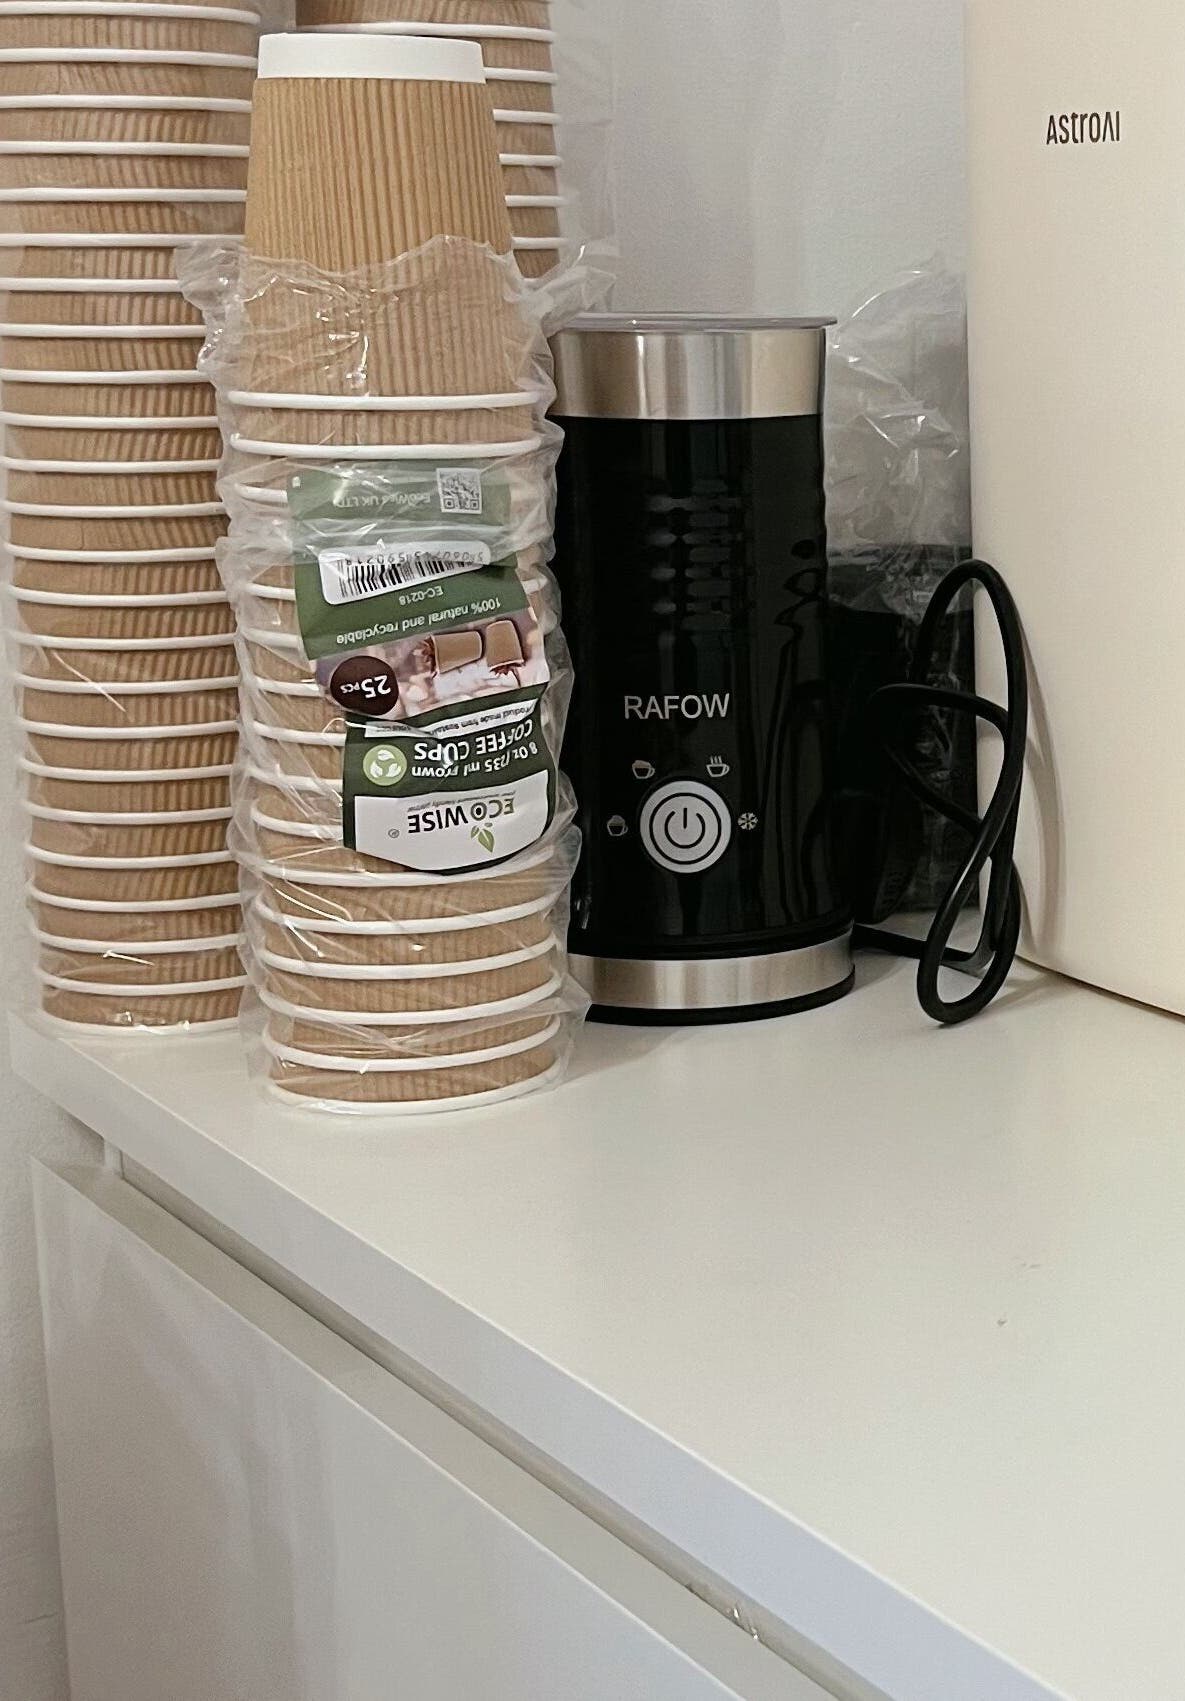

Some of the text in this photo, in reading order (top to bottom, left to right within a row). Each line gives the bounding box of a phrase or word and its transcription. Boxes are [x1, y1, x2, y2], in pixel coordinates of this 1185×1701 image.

[1046, 110, 1120, 145] AstroAI
[398, 585, 444, 605] EC-0218
[336, 596, 501, 645] 100% natural and recyclable
[360, 673, 391, 698] 25
[624, 693, 730, 720] RAFOW
[413, 719, 534, 762] COFFEE CUPS
[528, 741, 539, 755] 8
[463, 761, 481, 777] ml
